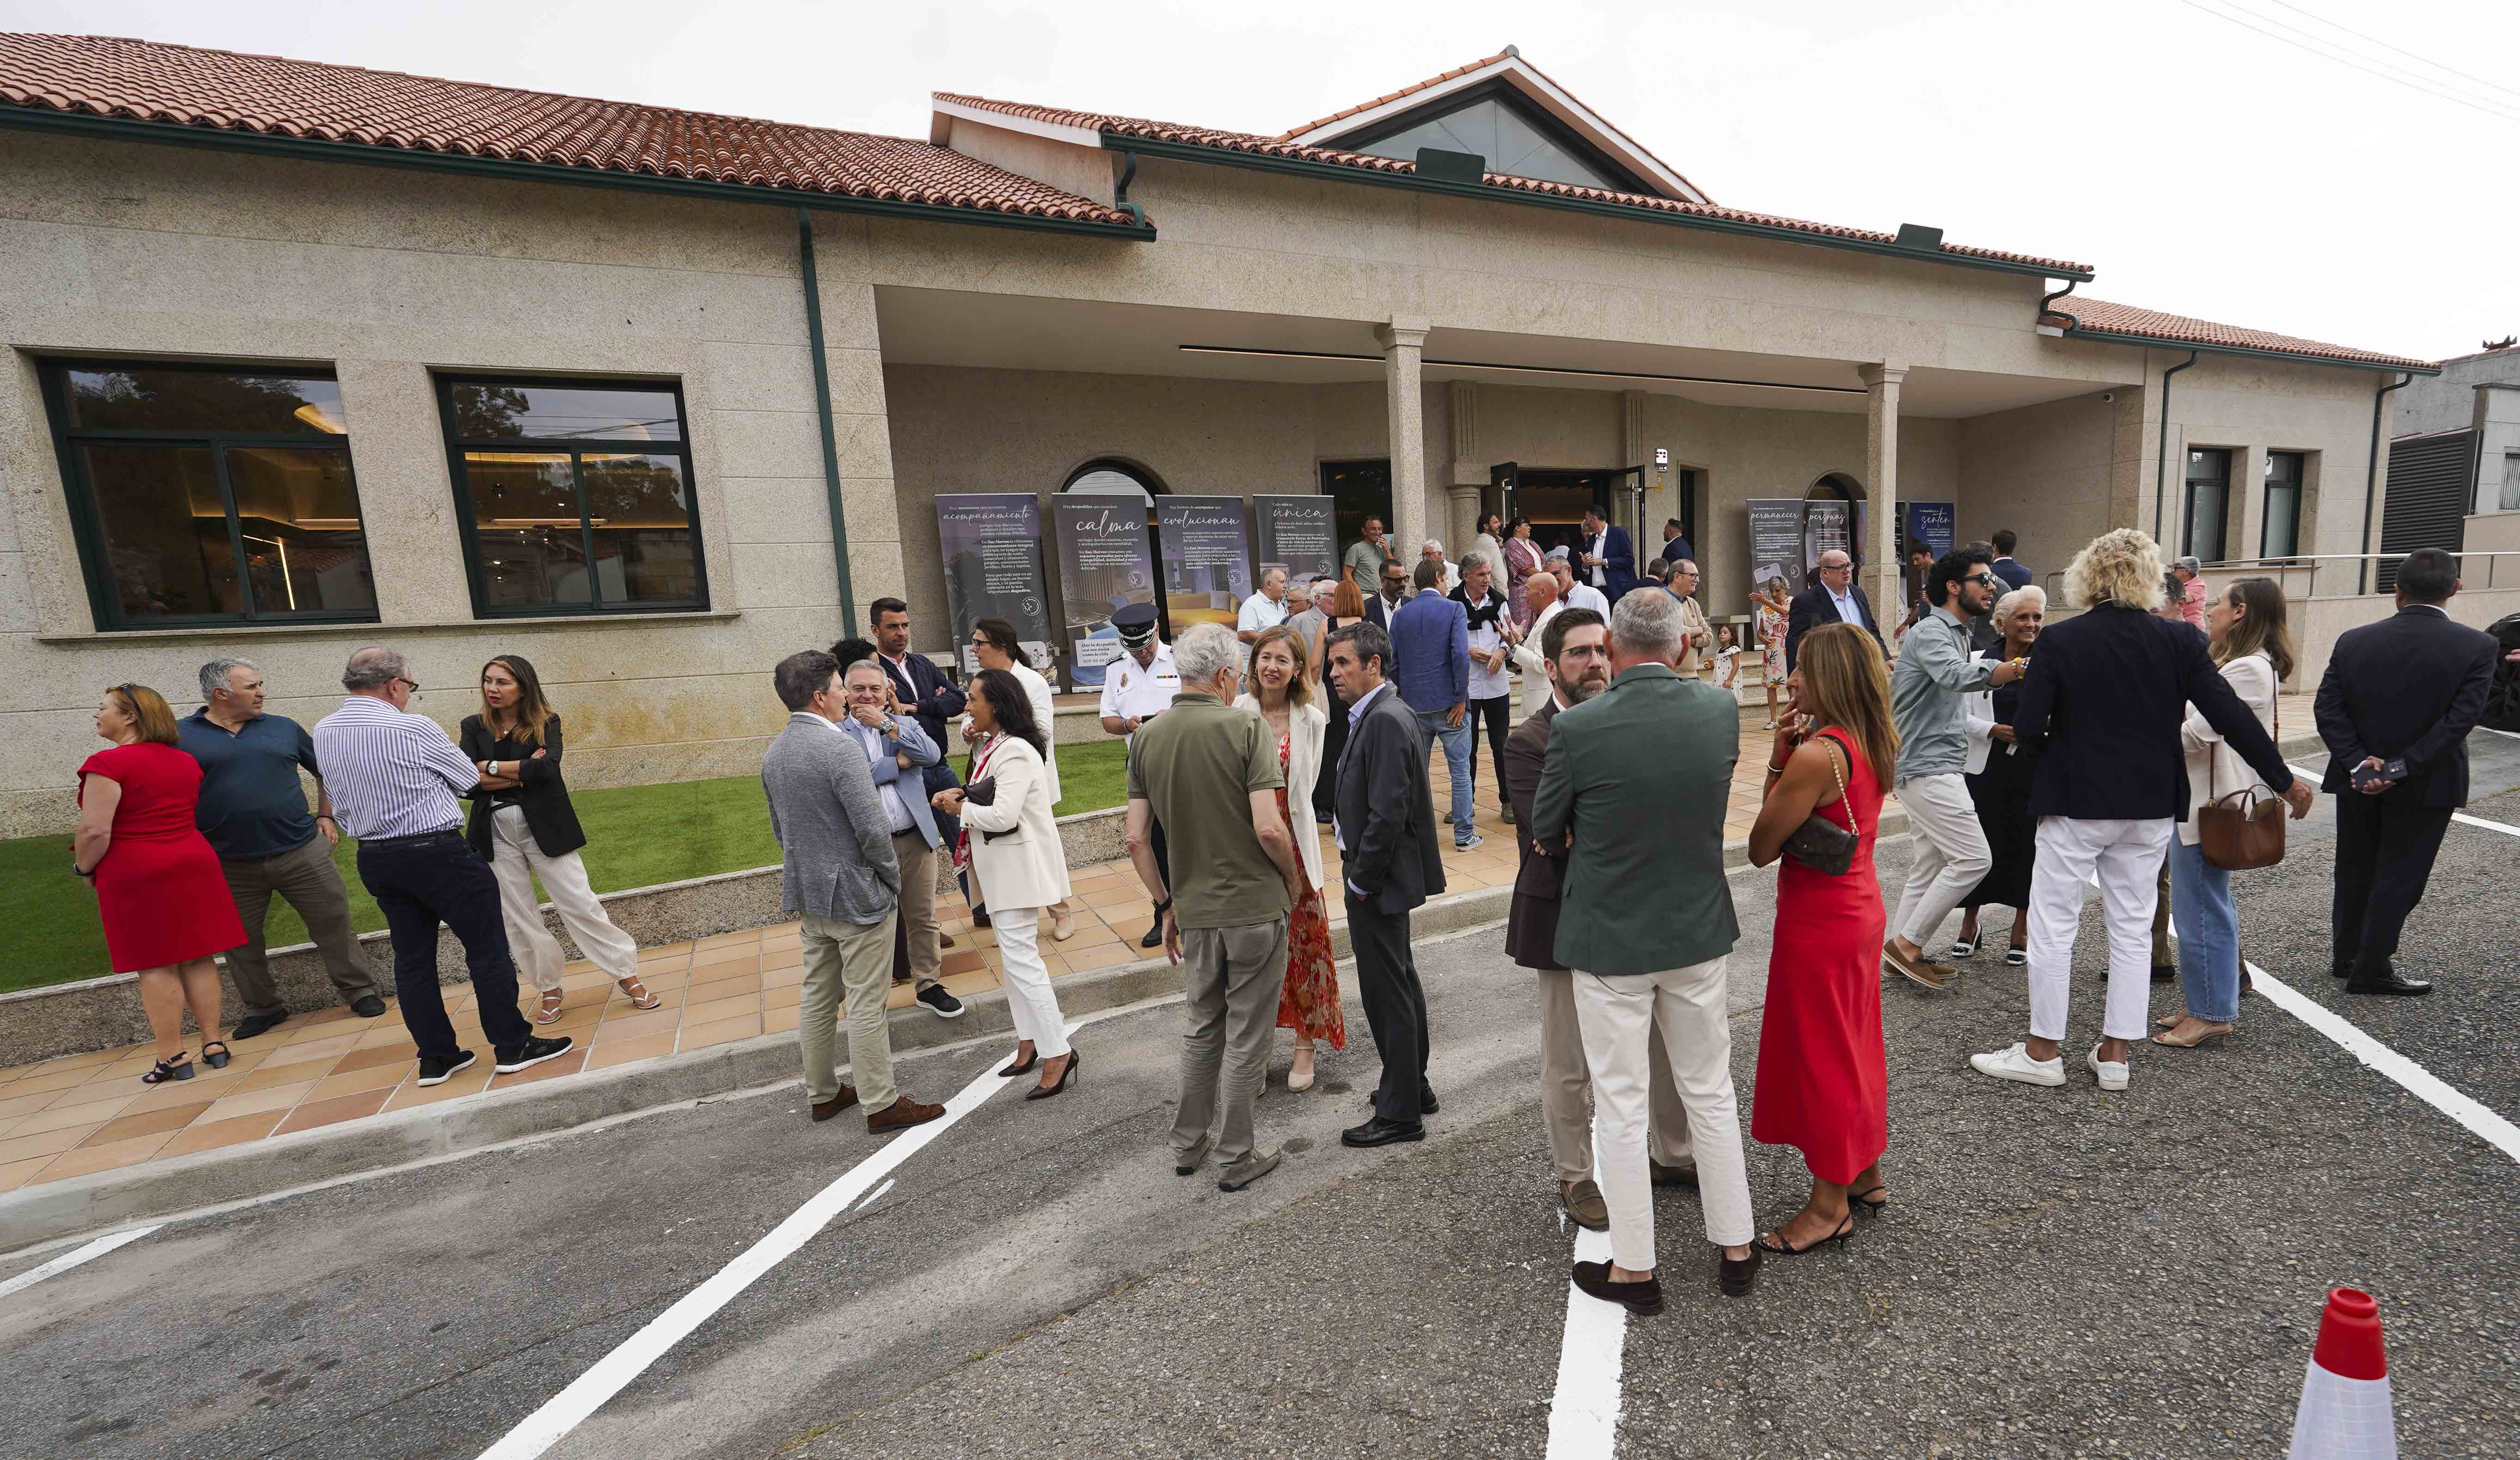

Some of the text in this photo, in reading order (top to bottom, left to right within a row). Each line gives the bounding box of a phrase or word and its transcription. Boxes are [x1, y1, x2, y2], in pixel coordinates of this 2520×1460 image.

[943, 505, 1034, 526] acompañamiento
[1164, 510, 1240, 529] evolucionan
[1273, 506, 1328, 518] única
[1750, 512, 1800, 525] permanecer
[1076, 510, 1141, 537] calma
